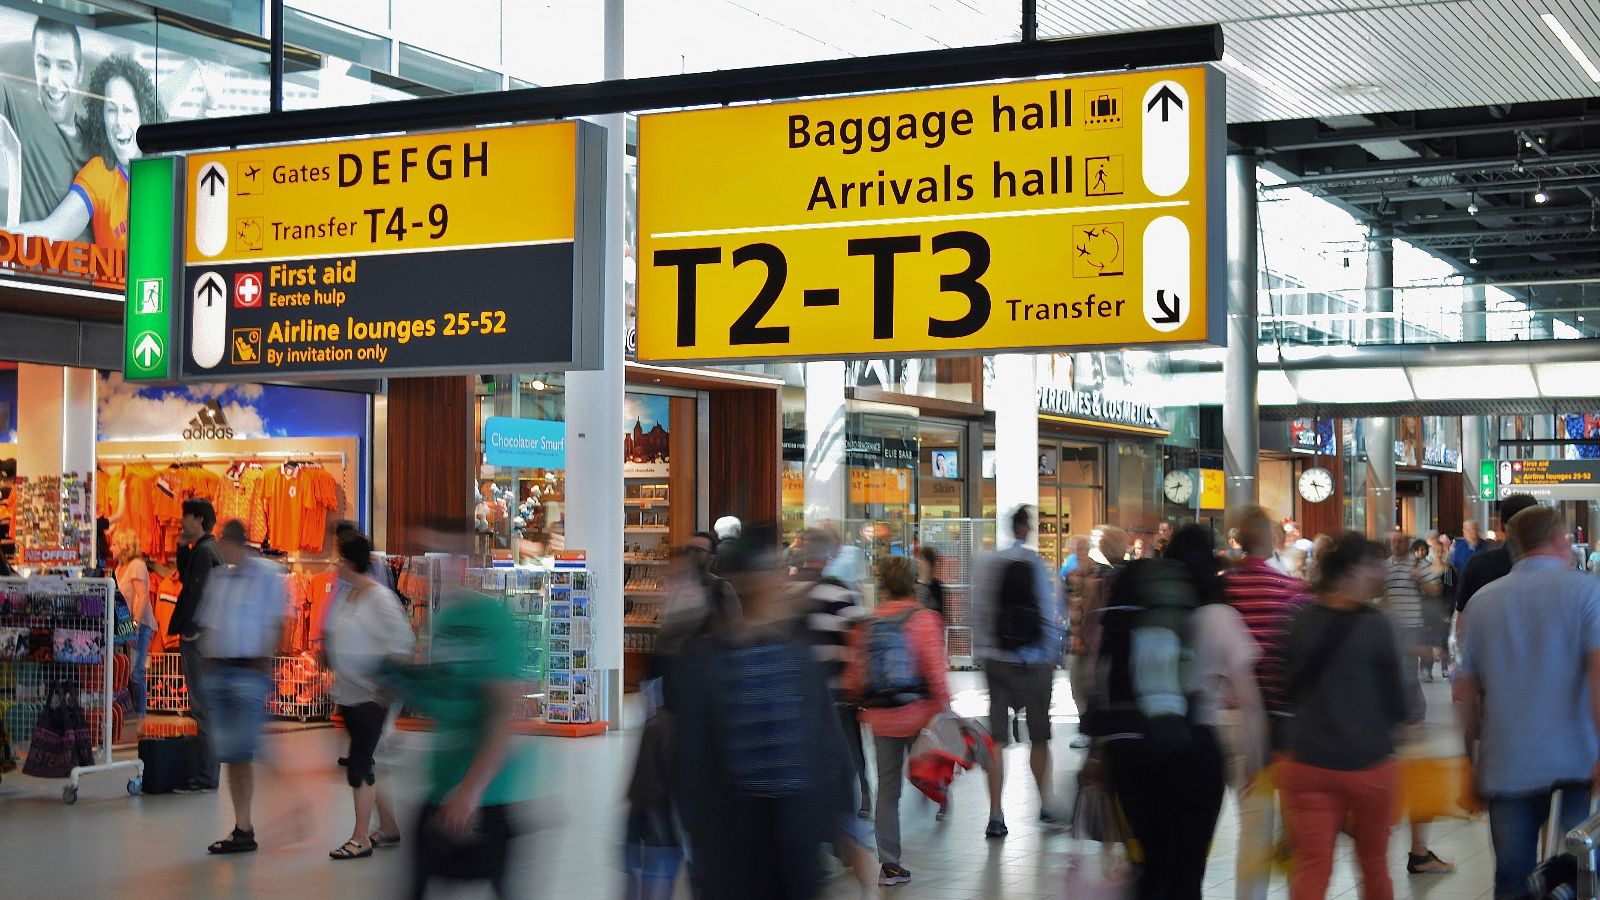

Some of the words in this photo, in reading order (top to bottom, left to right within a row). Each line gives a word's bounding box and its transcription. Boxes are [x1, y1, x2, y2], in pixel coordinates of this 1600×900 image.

[788, 108, 974, 155] Baggage
[992, 89, 1072, 132] hall
[272, 165, 330, 184] Gates
[807, 164, 974, 210] Arrivals
[993, 155, 1072, 198] hall
[272, 217, 357, 240] Transfer
[363, 203, 448, 243] T4-9
[270, 264, 316, 287] First
[322, 259, 357, 284] aid
[269, 292, 310, 307] Eerste
[314, 288, 346, 307] hulp
[653, 230, 992, 347] T2-T3
[1006, 294, 1126, 322] Transfer
[267, 318, 340, 344] Airline
[347, 317, 436, 344] lounges
[442, 310, 507, 336] 25-52
[267, 348, 283, 367] By
[287, 346, 353, 363] invitation
[357, 343, 388, 363] only
[183, 426, 234, 440] adidas
[491, 432, 539, 448] Chocolatier
[932, 483, 956, 494] Skin
[41, 549, 77, 561] OFFER
